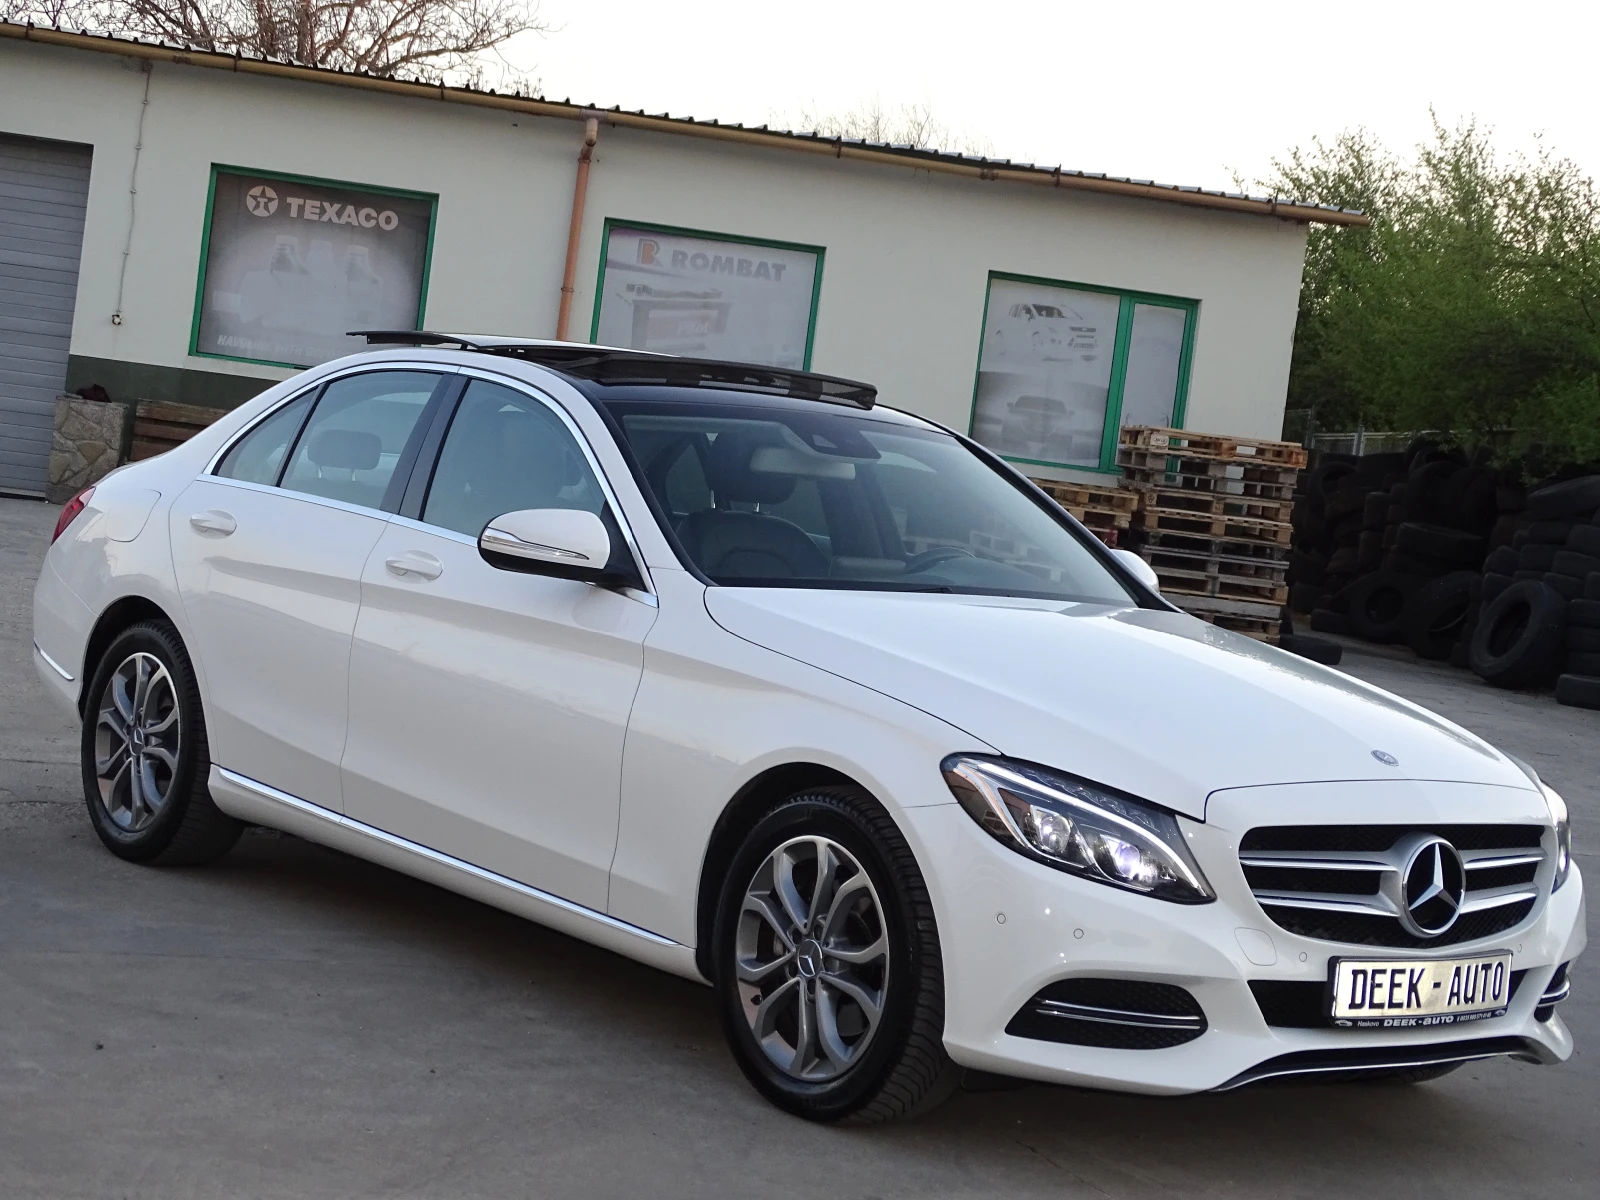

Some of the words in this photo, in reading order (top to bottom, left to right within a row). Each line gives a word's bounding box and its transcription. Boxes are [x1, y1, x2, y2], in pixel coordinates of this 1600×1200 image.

[286, 196, 399, 231] TEXACO
[671, 249, 787, 282] ROMBAT
[1348, 967, 1425, 1010] DEEK
[1447, 961, 1504, 1007] AUTO
